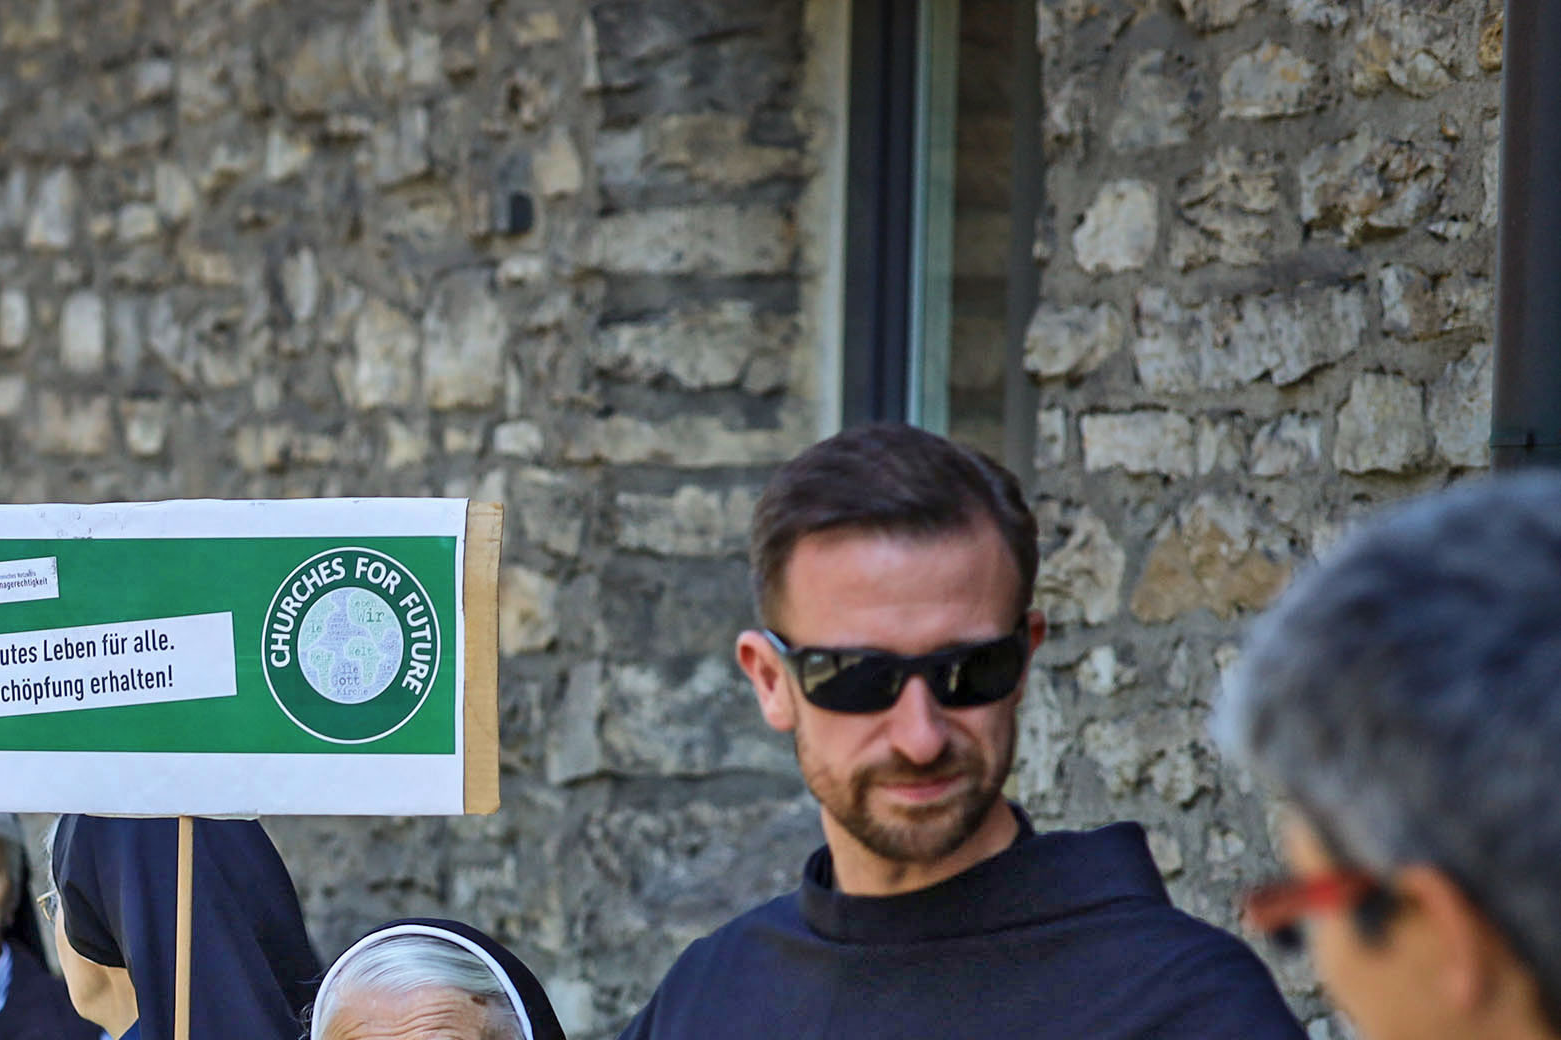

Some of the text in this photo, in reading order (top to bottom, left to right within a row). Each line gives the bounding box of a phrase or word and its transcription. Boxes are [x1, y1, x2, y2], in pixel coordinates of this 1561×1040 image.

[270, 557, 346, 668] CHURCHES
[355, 557, 402, 595] FOR
[399, 591, 432, 695] FUTURE
[43, 637, 97, 662] Leben
[102, 632, 128, 657] für
[133, 628, 175, 653] alle.
[90, 664, 174, 694] erhalten!
